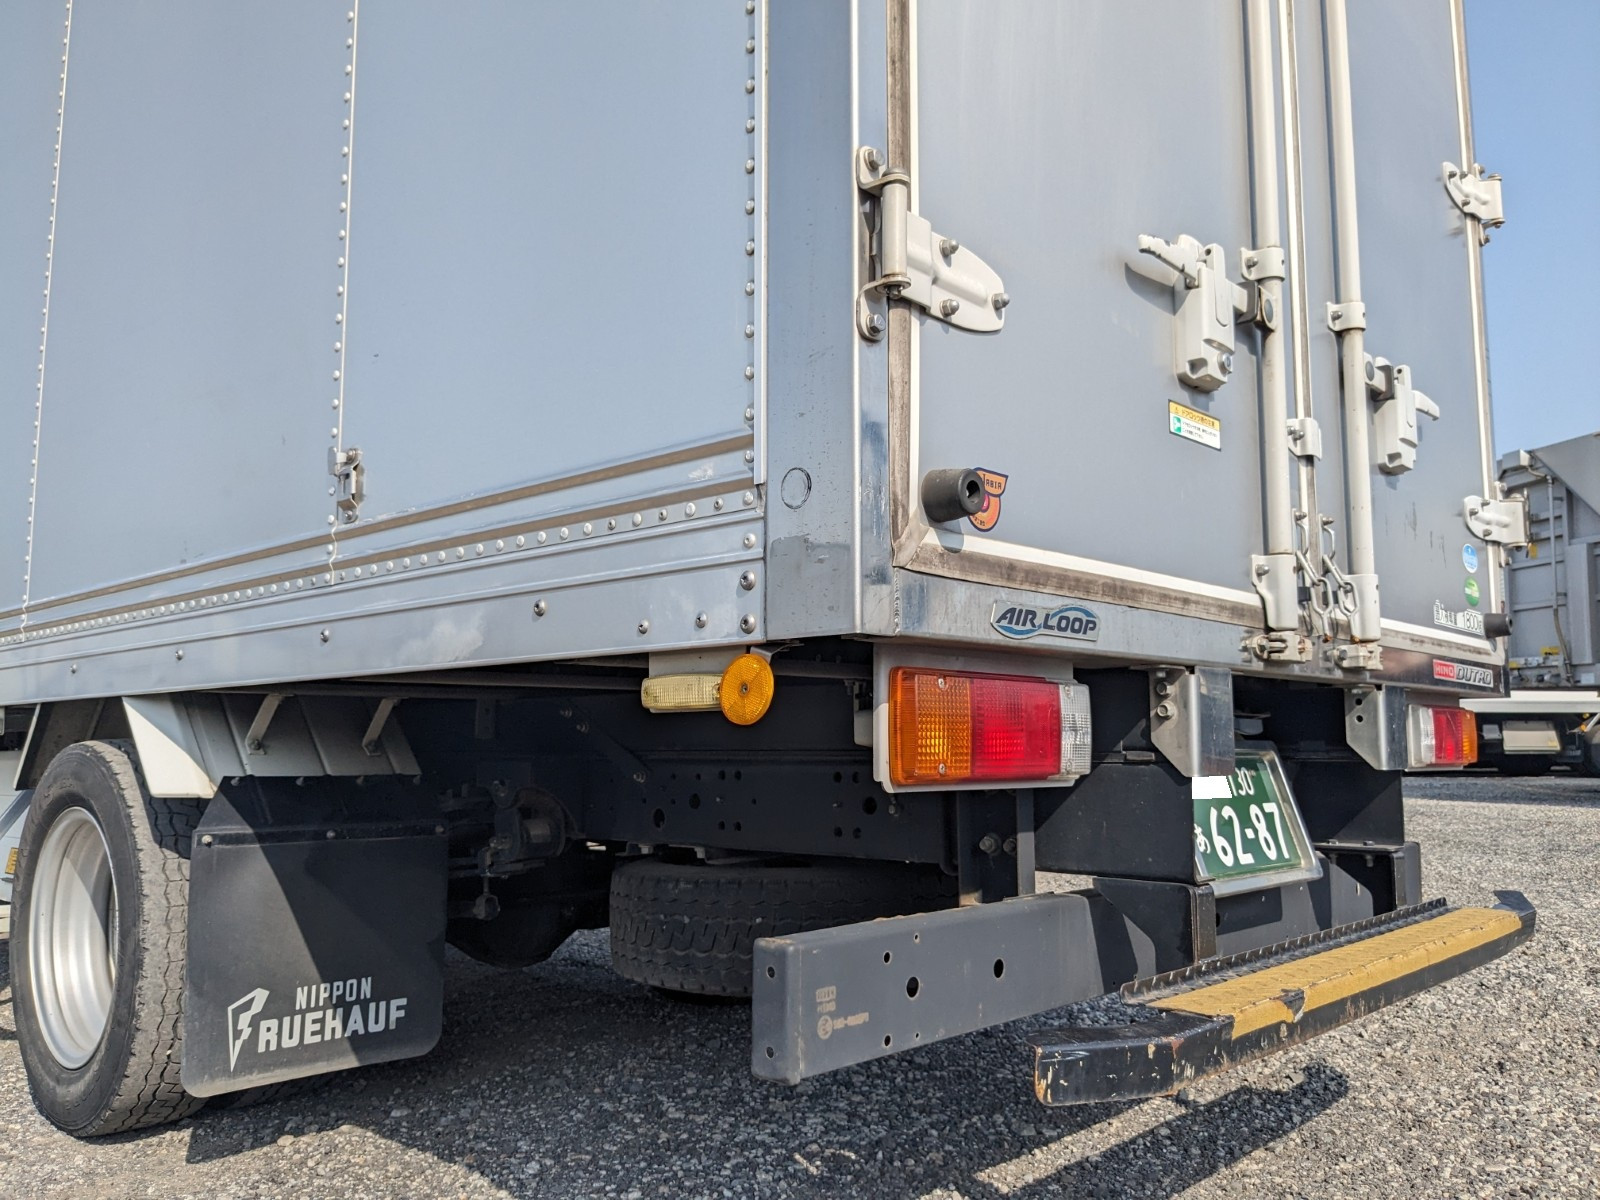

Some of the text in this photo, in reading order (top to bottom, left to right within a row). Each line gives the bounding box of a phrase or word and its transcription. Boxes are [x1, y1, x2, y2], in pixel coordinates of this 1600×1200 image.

[995, 607, 1097, 635] AIR LOOP
[1434, 662, 1492, 685] HINO DUTRO
[1210, 802, 1290, 867] 62-87
[295, 976, 373, 1011] NIPPON
